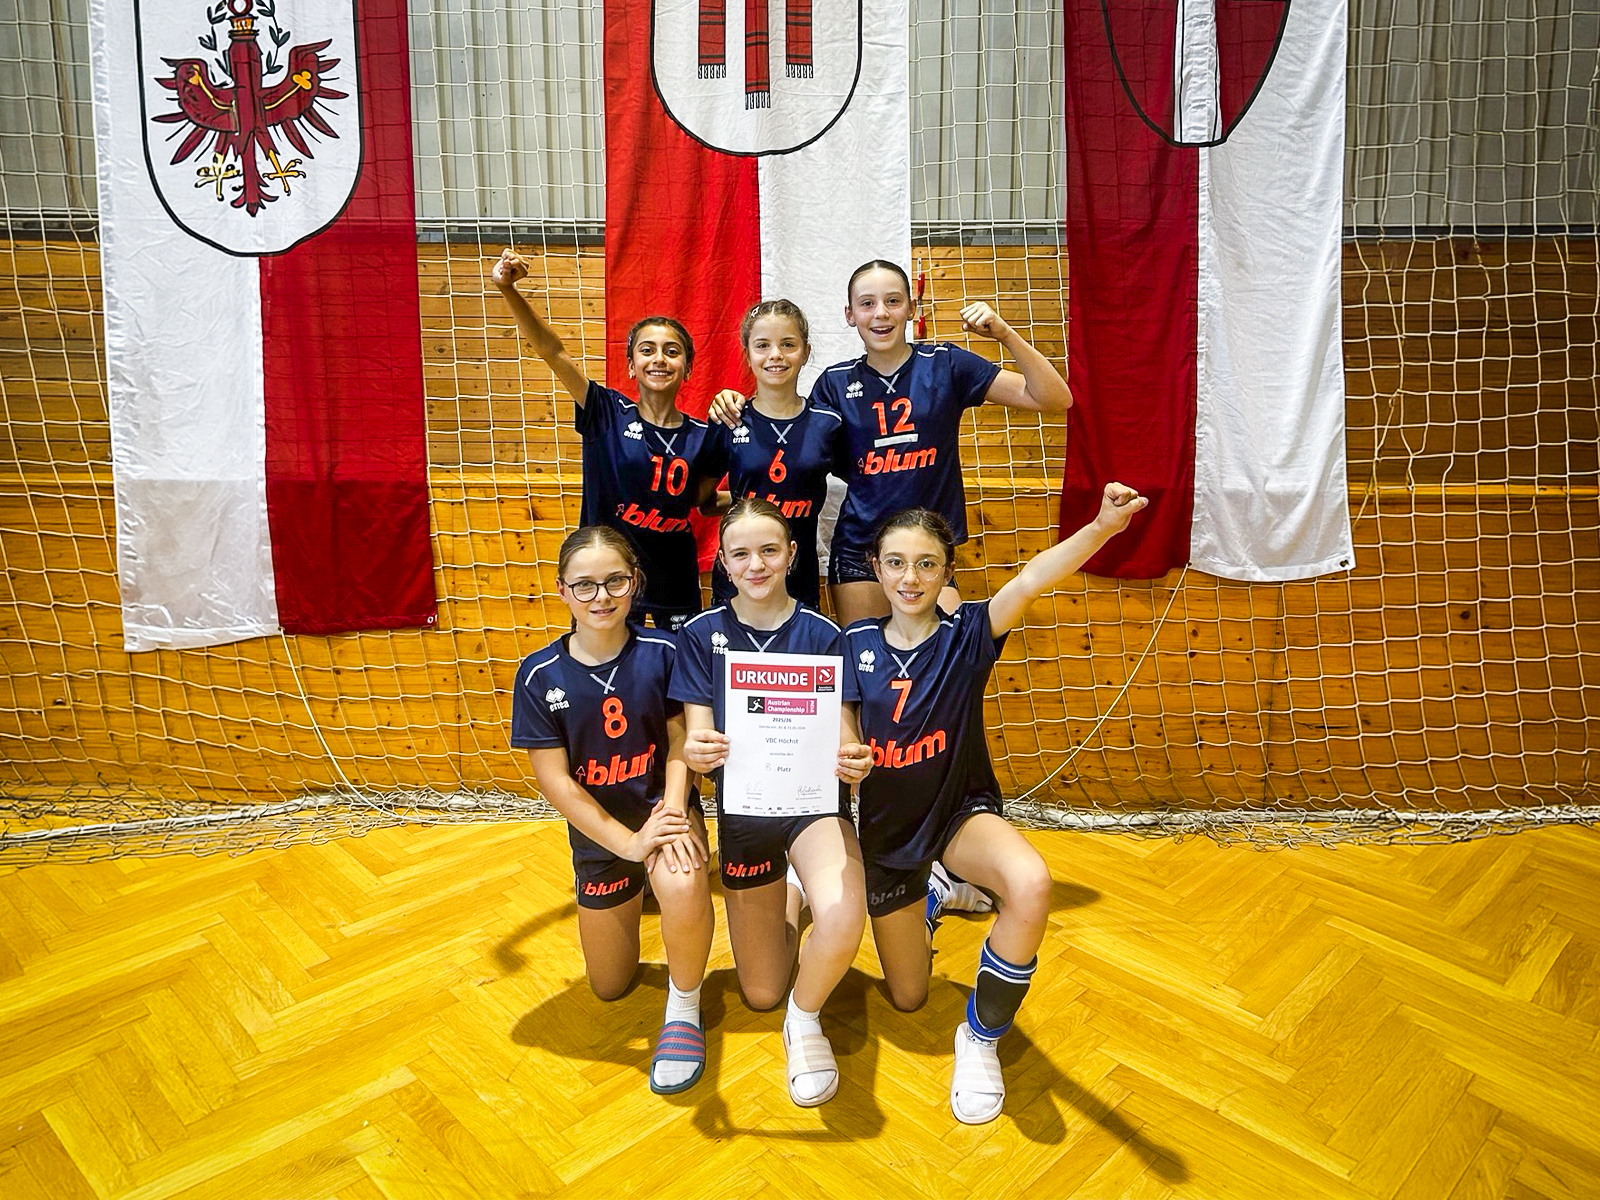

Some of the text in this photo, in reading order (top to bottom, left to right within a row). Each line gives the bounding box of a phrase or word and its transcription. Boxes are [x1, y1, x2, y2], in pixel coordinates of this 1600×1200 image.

[872, 398, 915, 435] 12
[651, 456, 689, 496] 10
[769, 449, 787, 483] 6
[864, 447, 937, 475] blum
[736, 669, 808, 686] URKUNDE
[603, 697, 628, 739] 8
[891, 680, 913, 724] 7
[870, 730, 946, 769] blum
[726, 860, 771, 877] blum
[585, 877, 629, 896] blum
